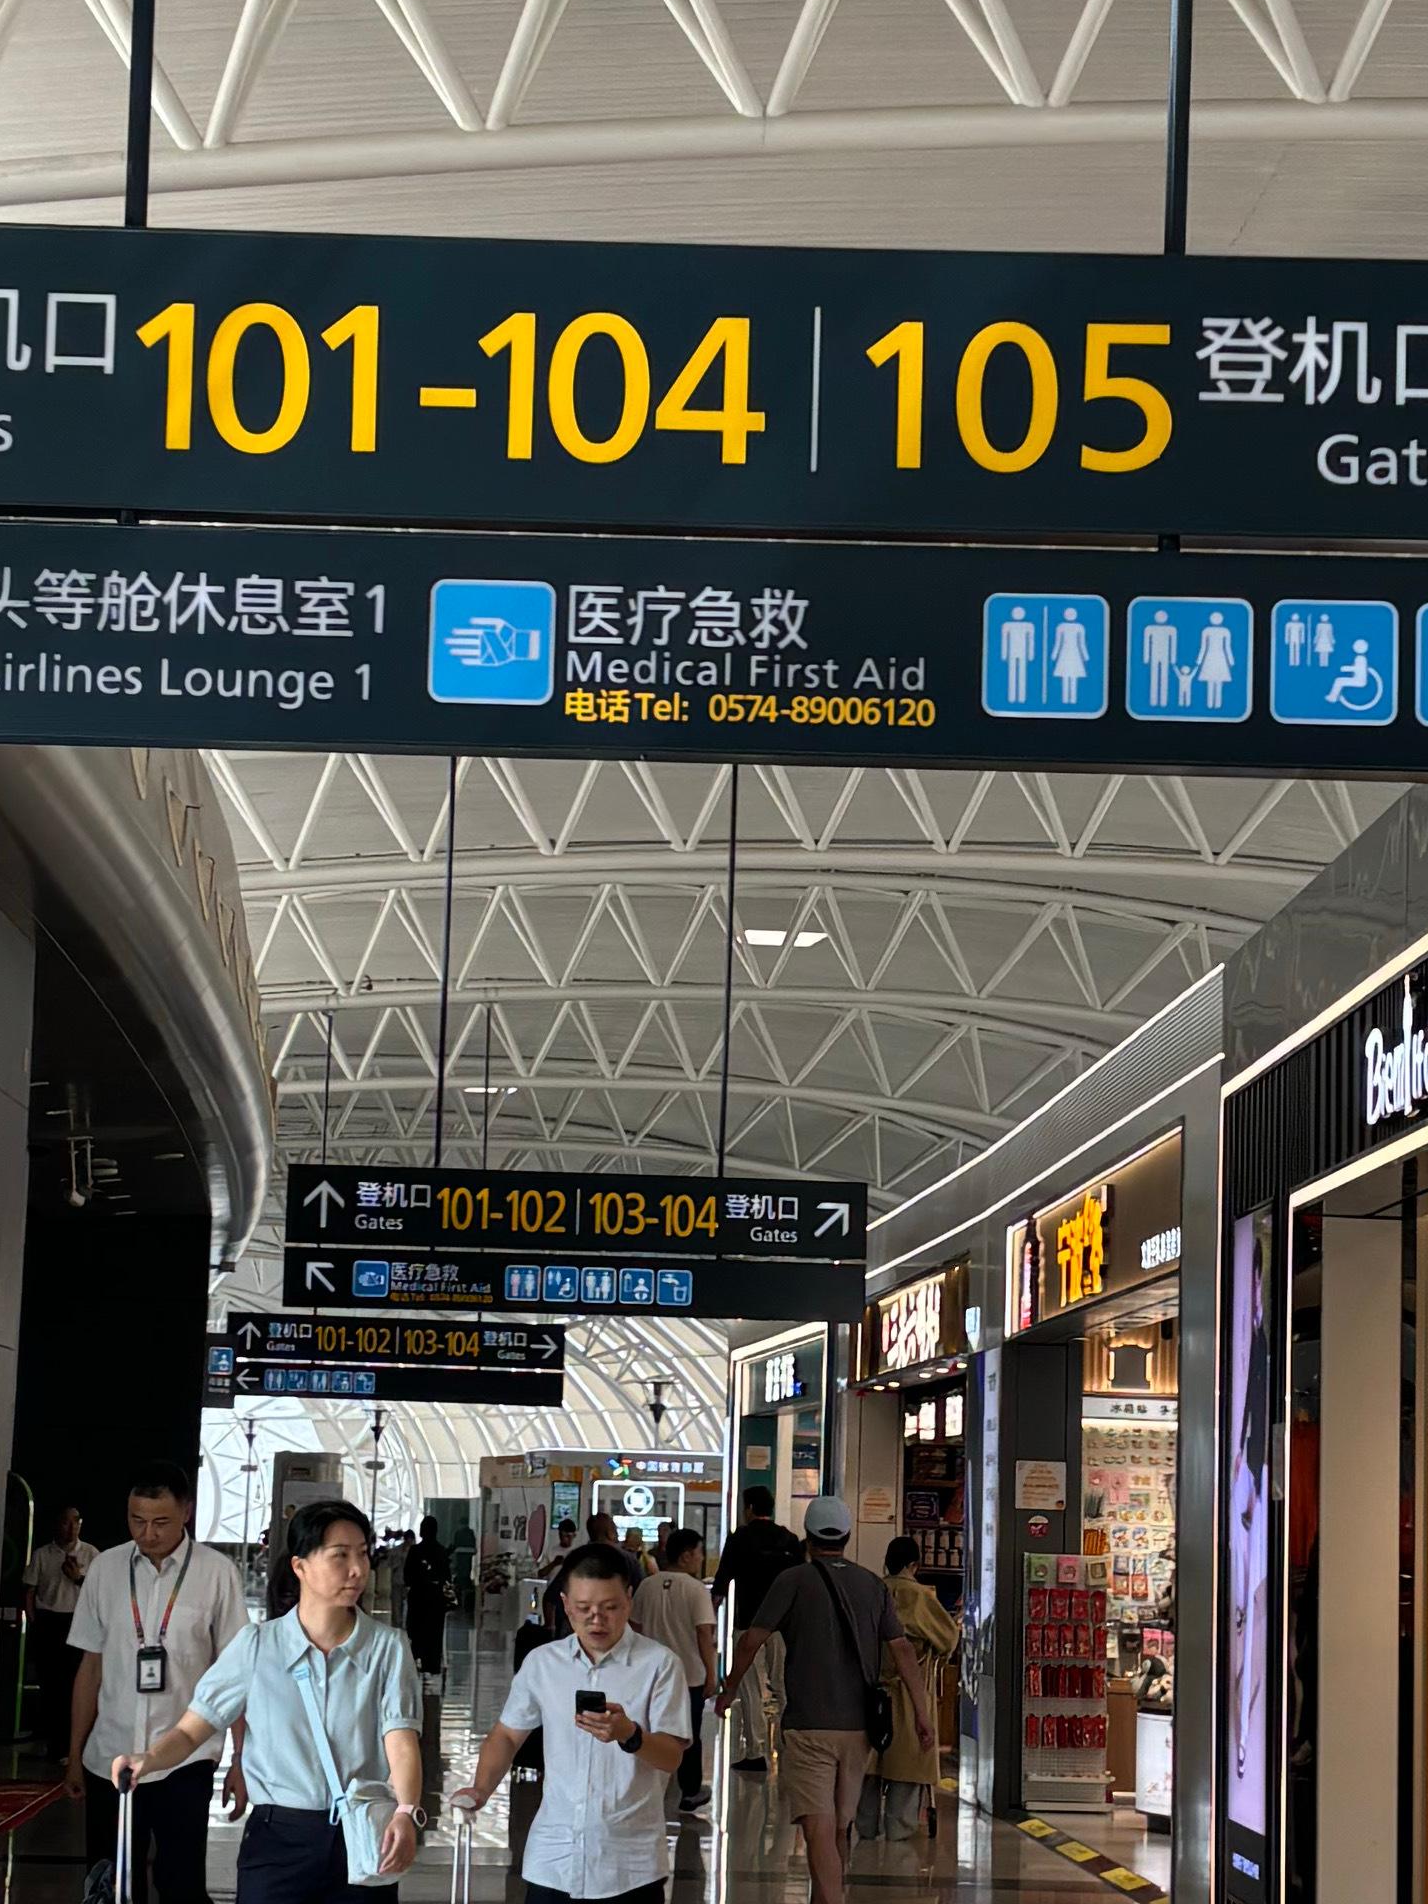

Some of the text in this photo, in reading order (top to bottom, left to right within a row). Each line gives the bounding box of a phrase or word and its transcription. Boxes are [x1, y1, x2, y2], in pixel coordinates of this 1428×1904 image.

[136, 302, 766, 465] 101-104
[865, 321, 1173, 474] 105
[567, 584, 810, 650] 医疗急救
[160, 658, 335, 710] Lounge
[355, 664, 371, 700] 1
[566, 651, 925, 691] Medical First Aid
[708, 694, 936, 727] 0574-89006120
[354, 1214, 404, 1230] Gates
[355, 1181, 567, 1233] 登机口 101-102
[588, 1192, 719, 1238] 103-104
[725, 1194, 799, 1220] 登机口
[750, 1226, 798, 1243] Gates
[391, 1262, 460, 1282] 医疗急救
[315, 1326, 391, 1354] 101-102
[404, 1330, 480, 1357] 103-104
